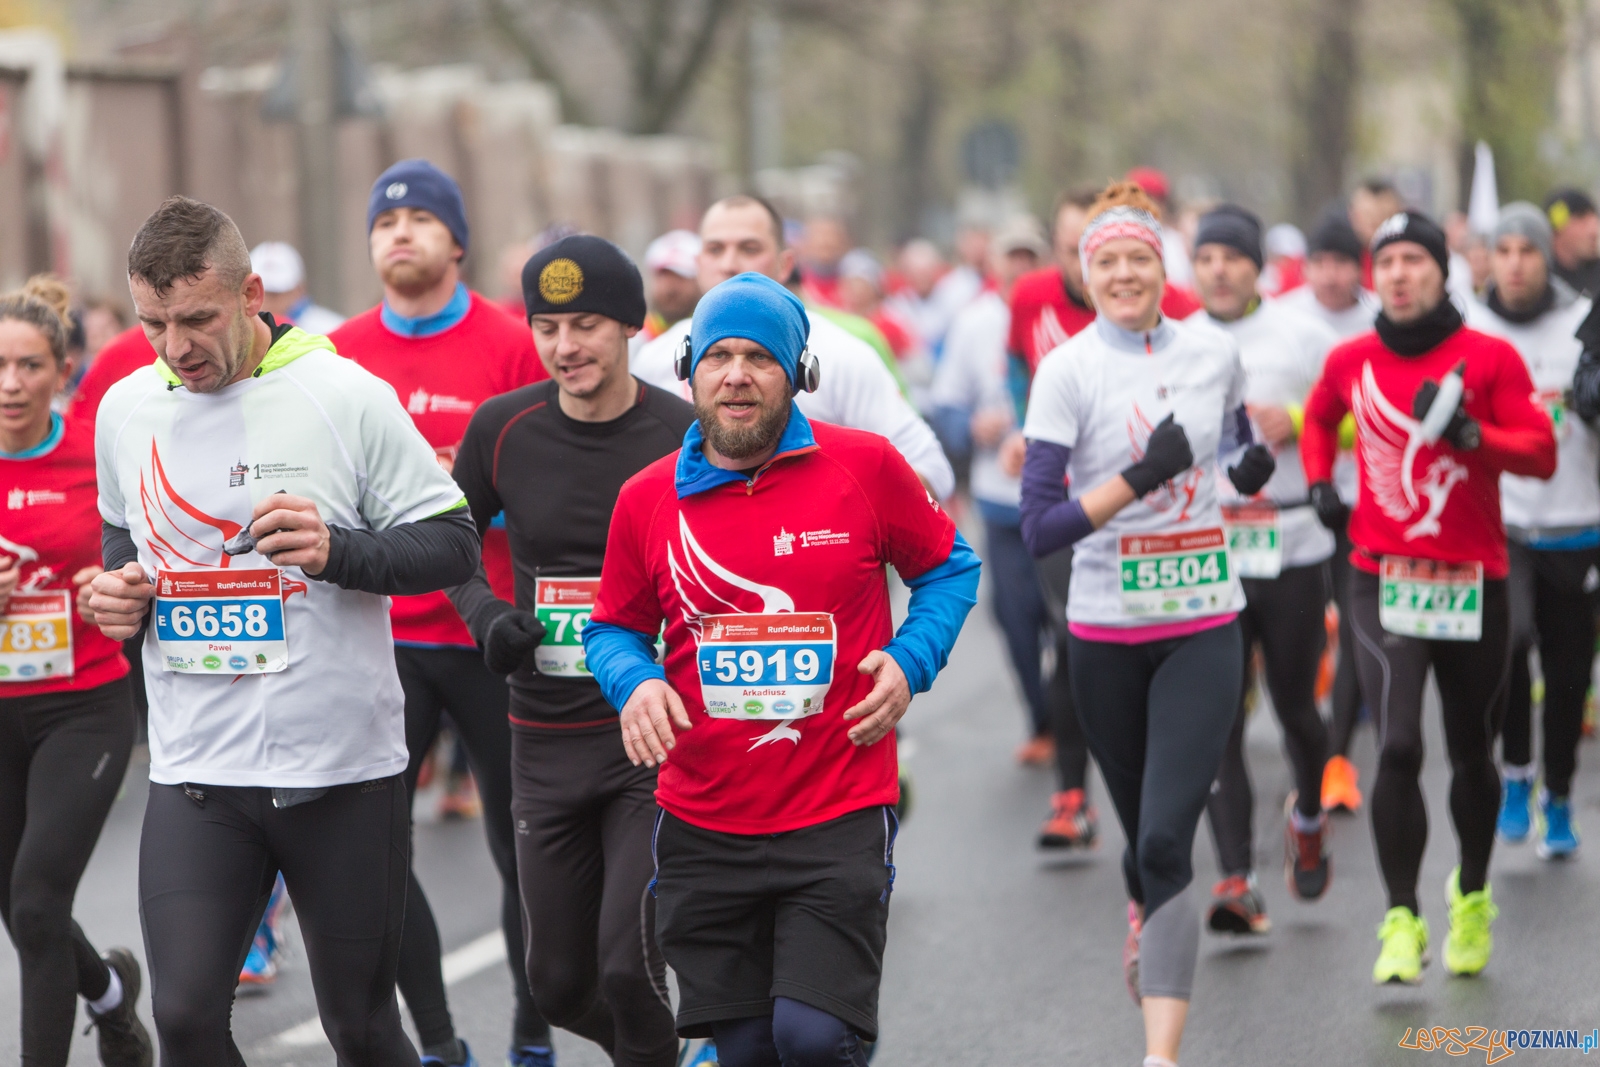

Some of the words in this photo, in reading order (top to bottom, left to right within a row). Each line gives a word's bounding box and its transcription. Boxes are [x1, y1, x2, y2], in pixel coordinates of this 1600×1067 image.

[253, 463, 262, 480] 1
[799, 531, 810, 548] 1
[1136, 553, 1221, 590] 5504
[174, 580, 181, 592] 1
[217, 581, 272, 590] RunPoland.org
[157, 615, 167, 627] E
[170, 604, 269, 638] 6658
[767, 625, 825, 634] RunPoland.org
[701, 660, 711, 671] E
[715, 648, 820, 682] 5919
[742, 689, 786, 697] Arkadiusz
[709, 706, 732, 714] LUXMED
